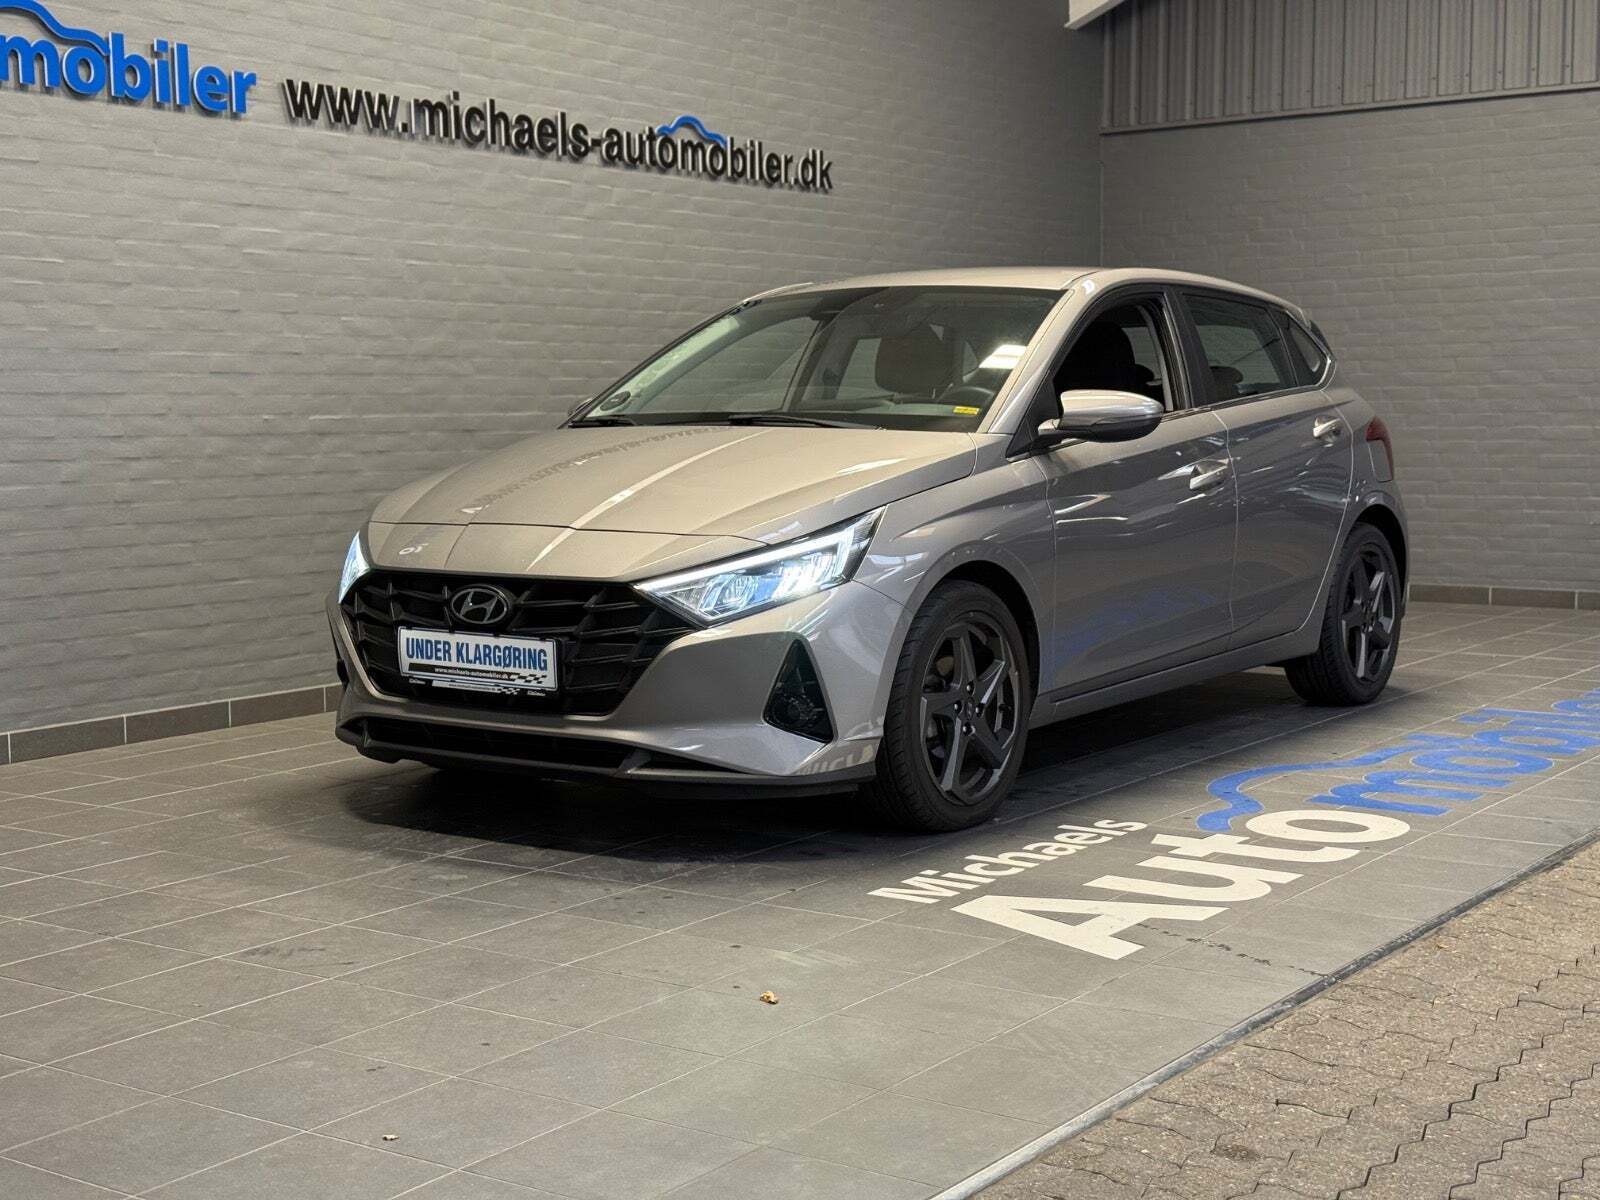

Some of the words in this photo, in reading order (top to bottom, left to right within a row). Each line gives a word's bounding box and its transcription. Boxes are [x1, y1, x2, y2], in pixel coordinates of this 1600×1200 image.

[283, 78, 833, 190] www.michaels-automobiler.dk
[405, 637, 452, 662] UNDER
[456, 641, 548, 671] KLARGØRING
[867, 819, 1148, 904] Michaels
